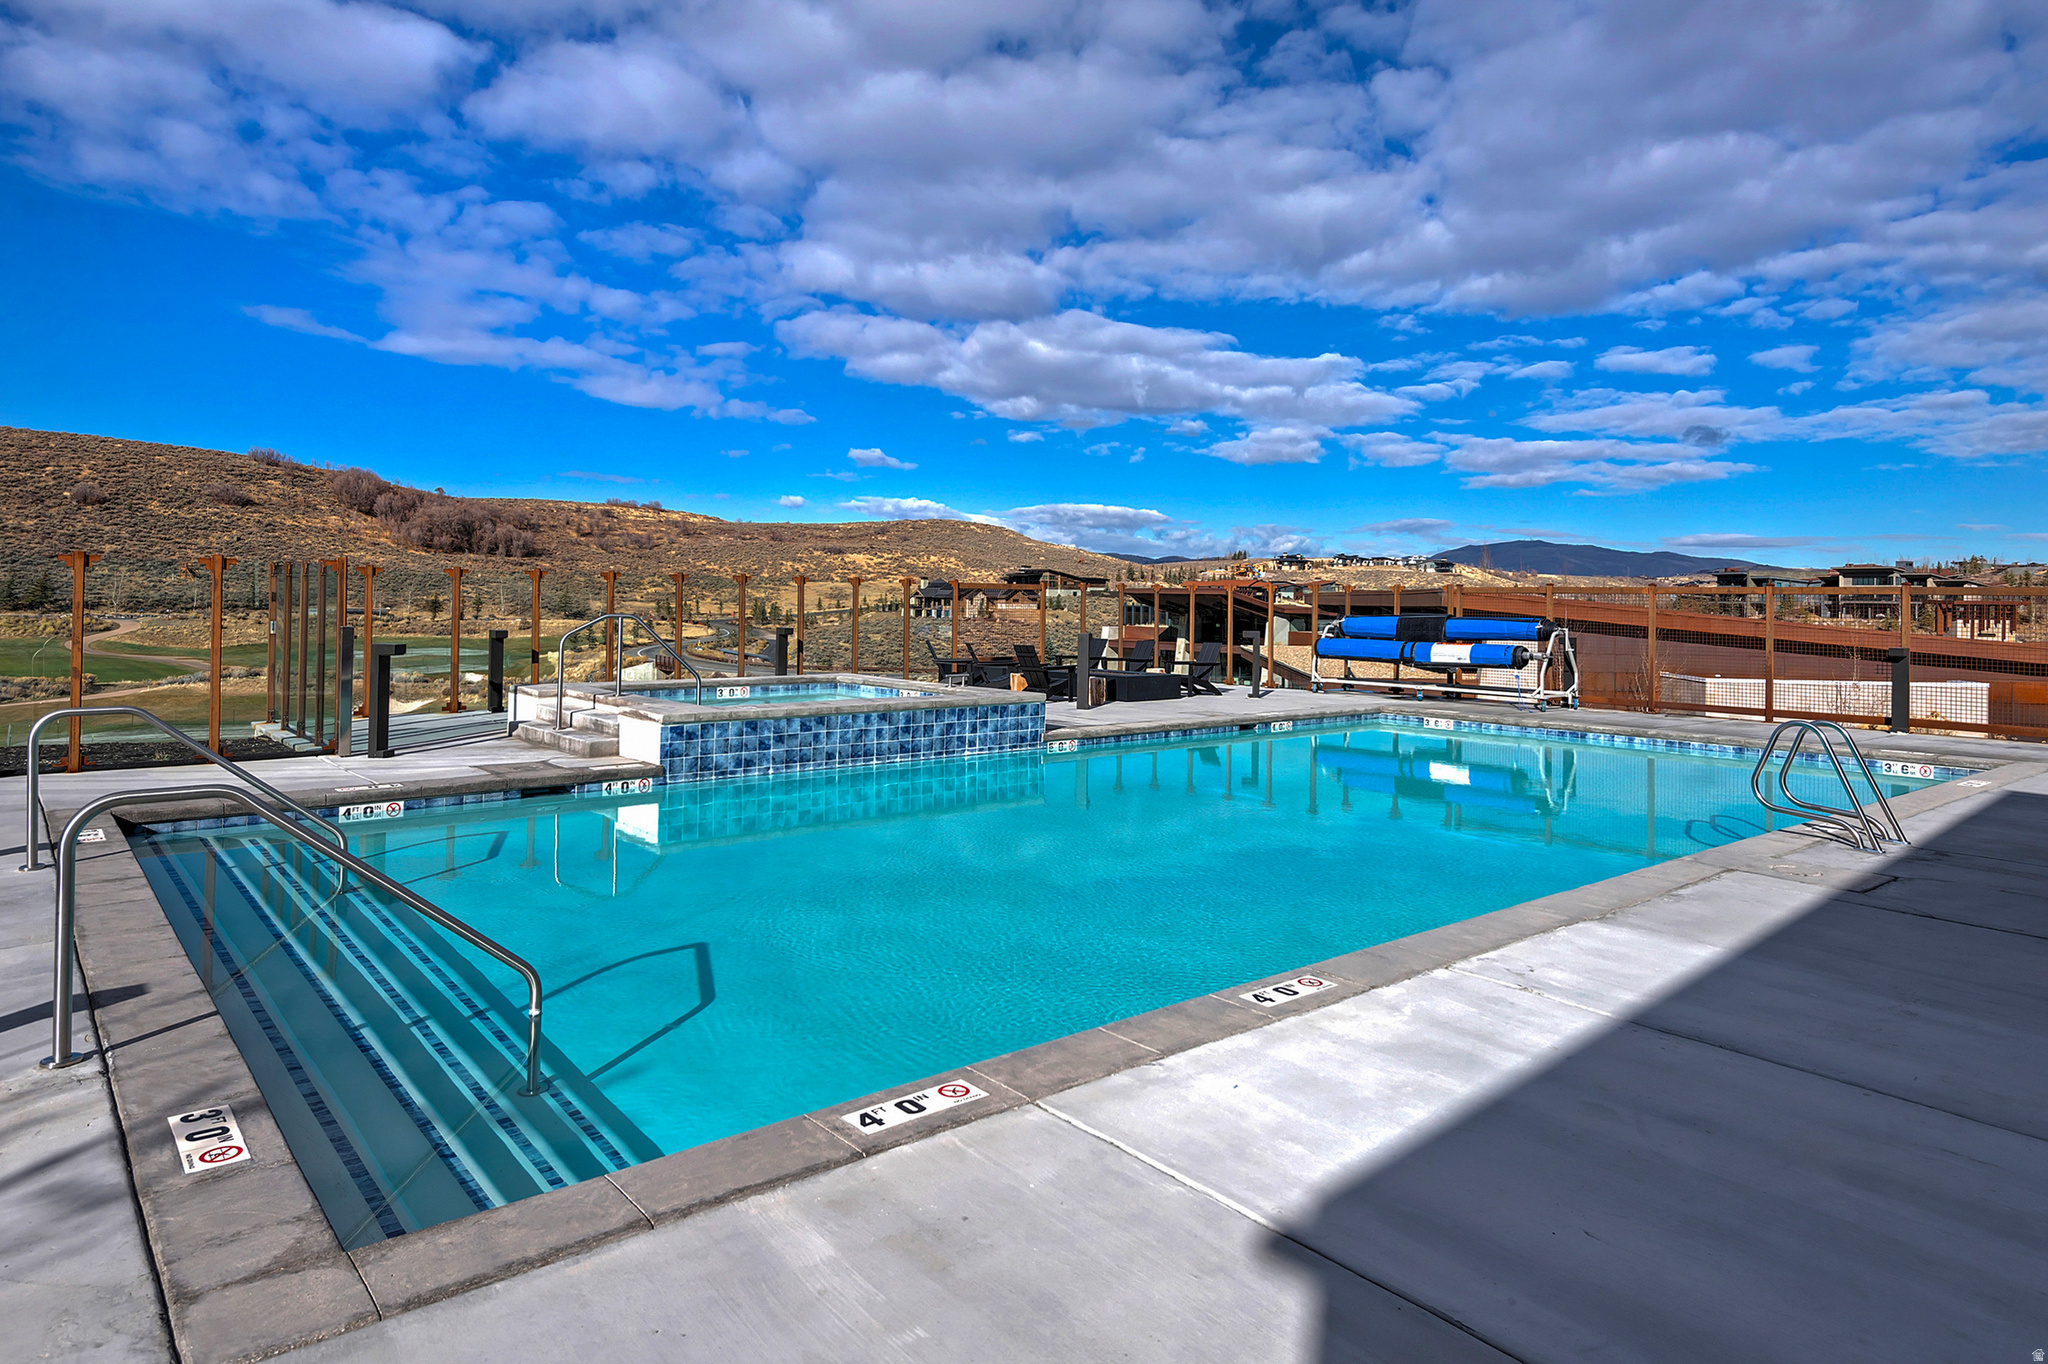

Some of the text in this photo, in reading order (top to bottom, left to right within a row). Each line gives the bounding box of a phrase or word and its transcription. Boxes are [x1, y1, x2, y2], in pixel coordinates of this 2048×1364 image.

[1884, 762, 1892, 773] 3
[1252, 993, 1276, 1003] 4
[1272, 986, 1299, 996] 0
[859, 1093, 929, 1128] 4 FT 0 IN
[180, 1109, 234, 1143] 3 FT 0 IN
